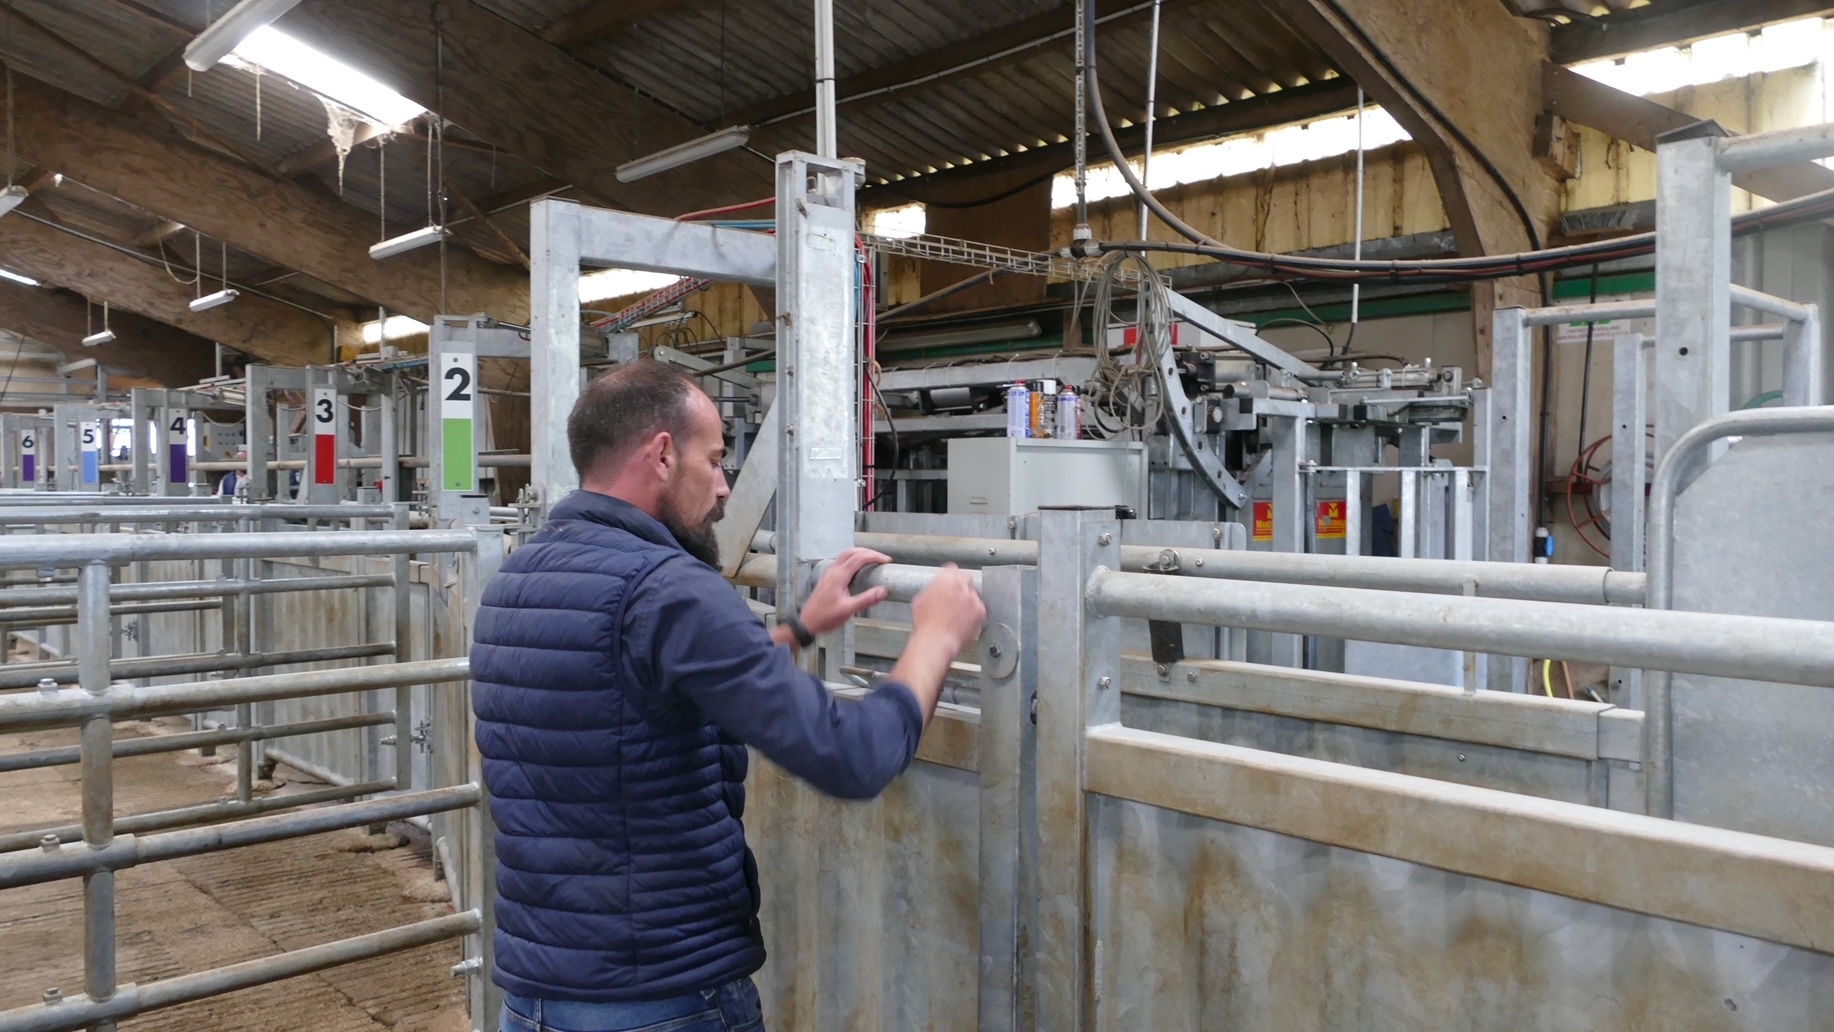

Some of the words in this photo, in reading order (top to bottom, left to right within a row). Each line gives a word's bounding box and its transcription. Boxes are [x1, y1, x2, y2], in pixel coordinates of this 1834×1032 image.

[444, 367, 471, 401] 2
[315, 399, 334, 423] 3
[170, 417, 186, 435] 4
[22, 435, 34, 448] 6
[82, 429, 95, 443] 5
